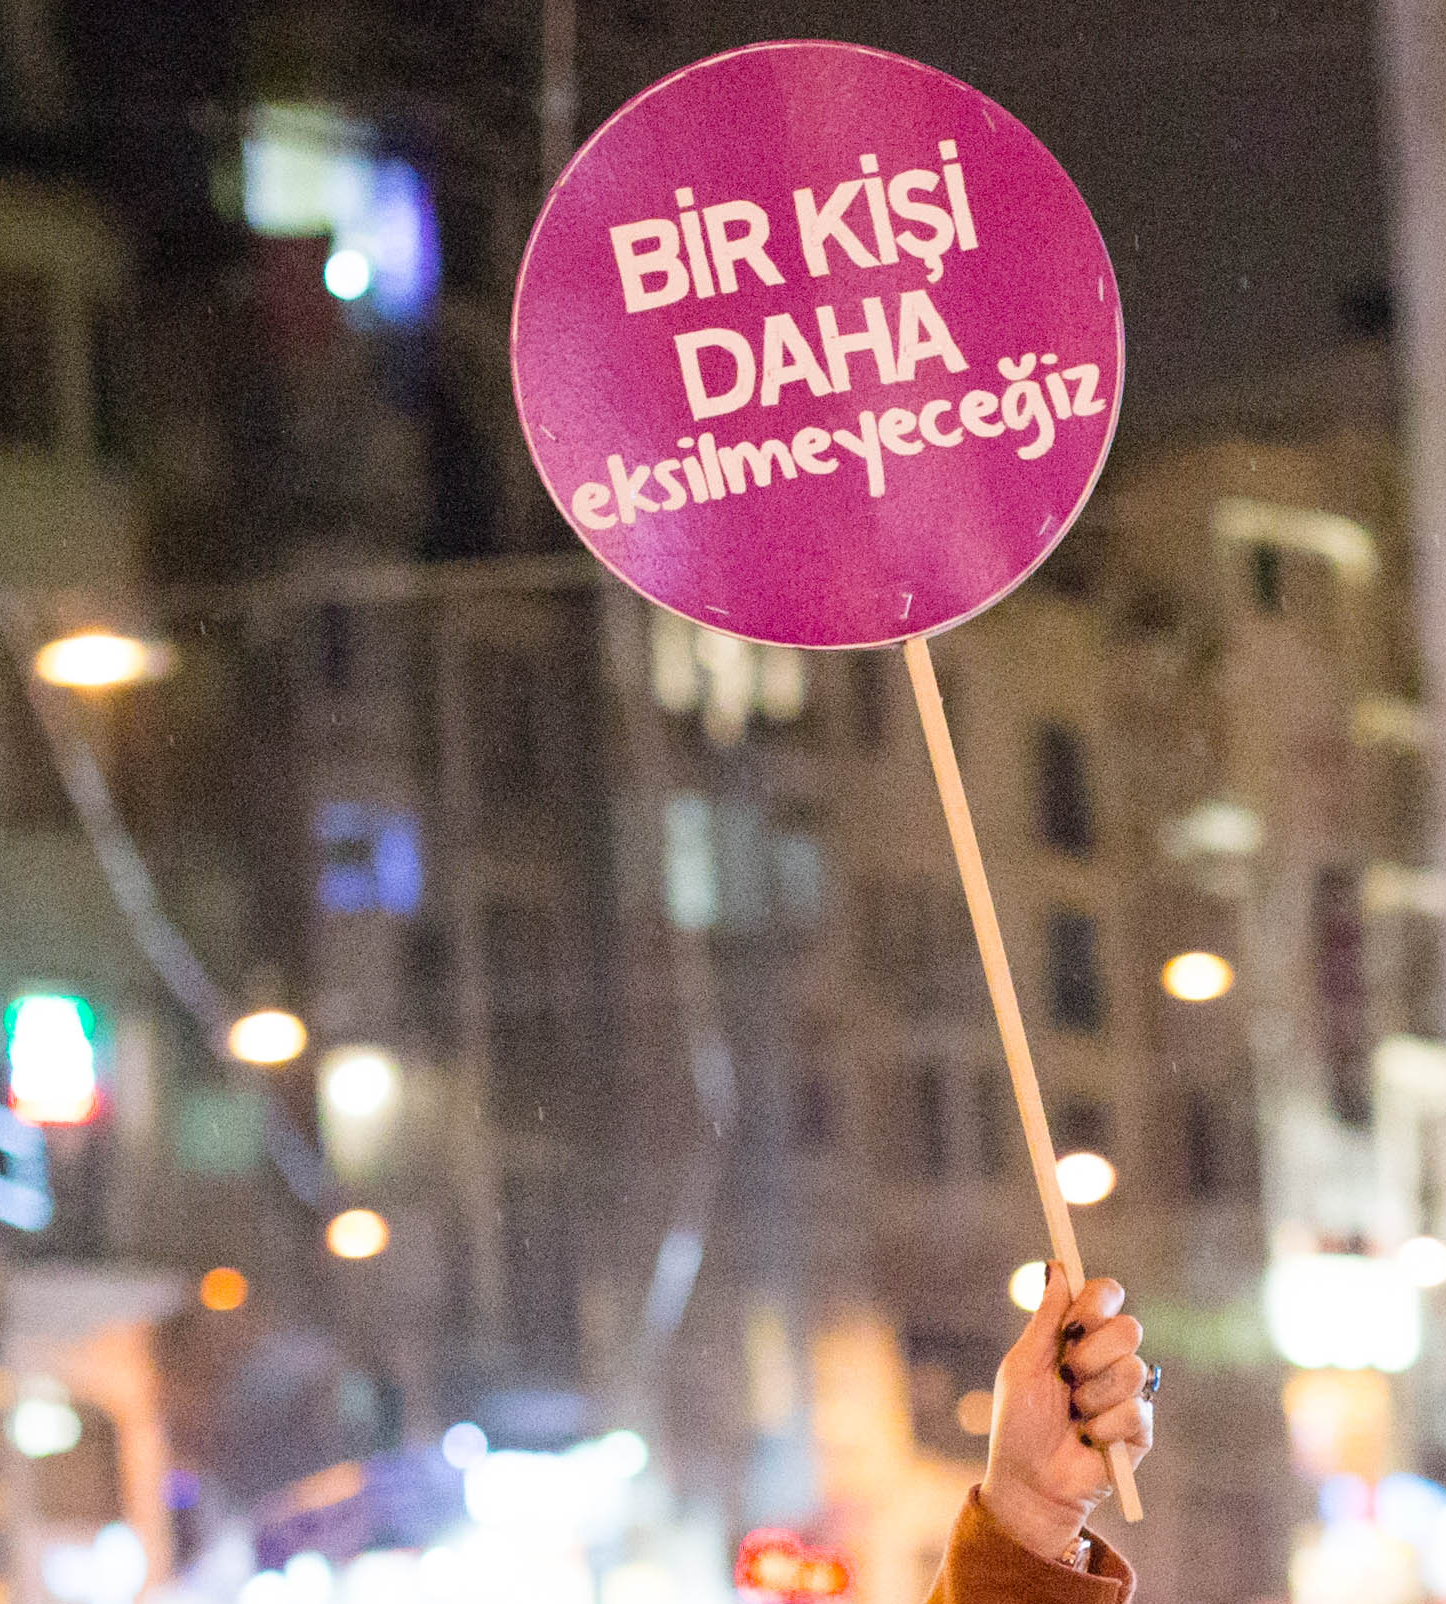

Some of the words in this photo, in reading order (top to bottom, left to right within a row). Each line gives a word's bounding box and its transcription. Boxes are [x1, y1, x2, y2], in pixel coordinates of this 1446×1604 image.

[608, 186, 786, 314] BİR
[793, 139, 979, 284] KİŞİ
[570, 352, 1107, 531] eksilmeyeceğiz
[673, 288, 970, 421] DAHA
